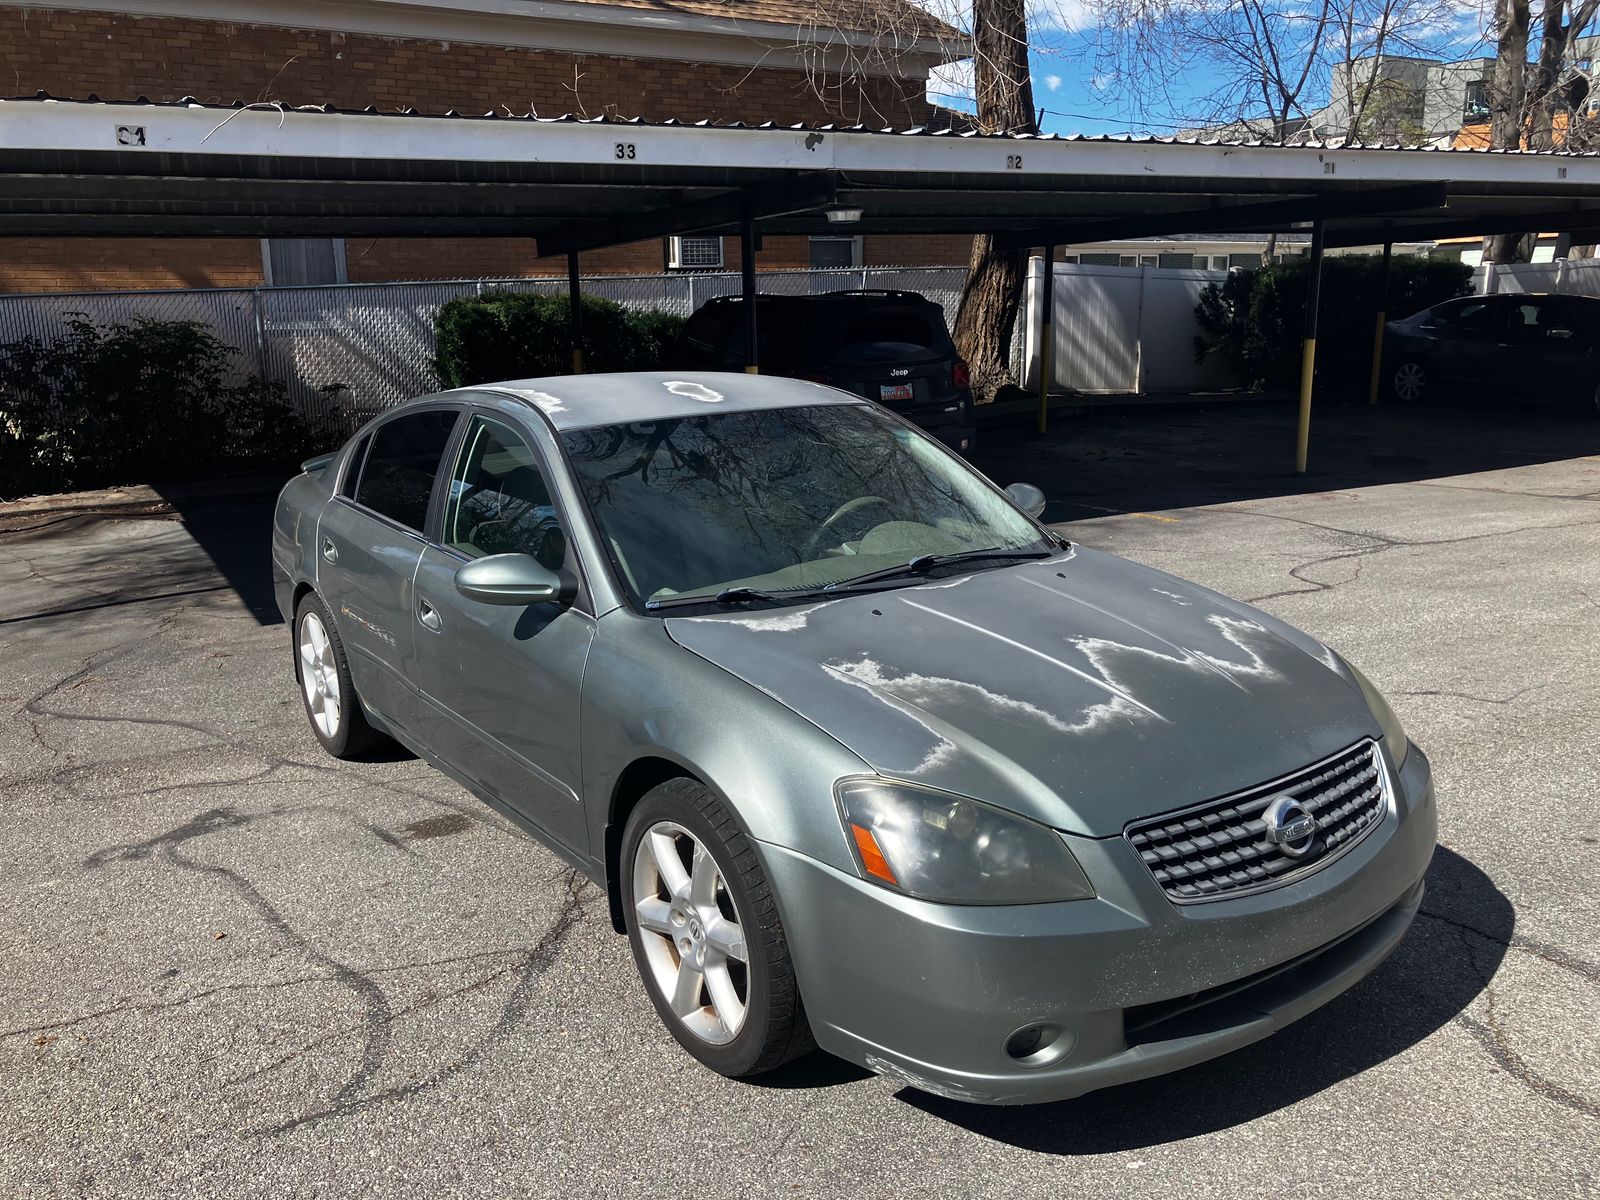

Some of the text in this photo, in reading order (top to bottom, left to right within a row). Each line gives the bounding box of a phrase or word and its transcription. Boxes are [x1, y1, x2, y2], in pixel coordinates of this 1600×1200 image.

[616, 143, 636, 160] 33
[1007, 155, 1022, 169] 32
[890, 368, 909, 377] Jeep
